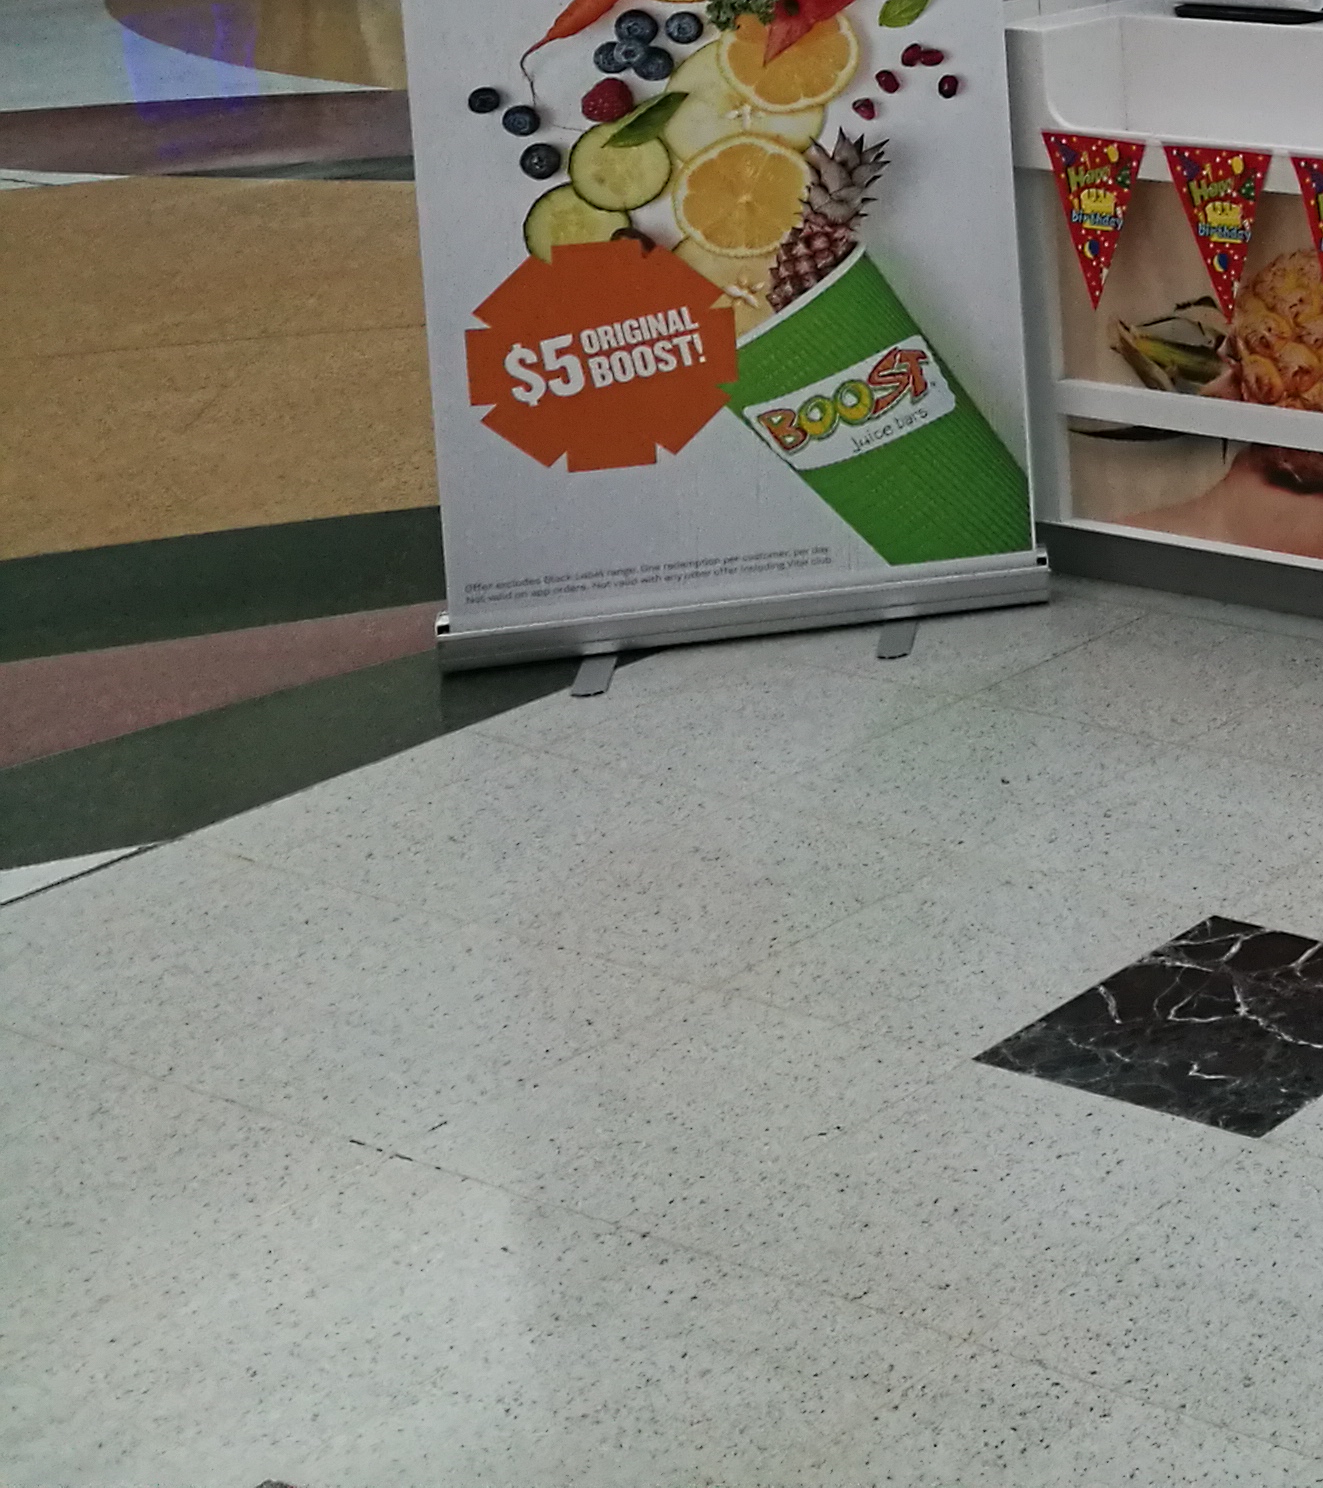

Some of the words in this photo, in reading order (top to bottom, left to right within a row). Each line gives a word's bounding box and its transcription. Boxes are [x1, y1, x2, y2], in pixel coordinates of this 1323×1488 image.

[504, 333, 586, 407] $5
[580, 306, 699, 354] ORIGINAL
[588, 333, 706, 388] BOOST!
[758, 347, 929, 455] BOOST
[851, 423, 894, 453] Juice
[895, 407, 929, 430] bars
[464, 582, 493, 594] Offer
[640, 575, 662, 584] with
[714, 566, 738, 576] offer
